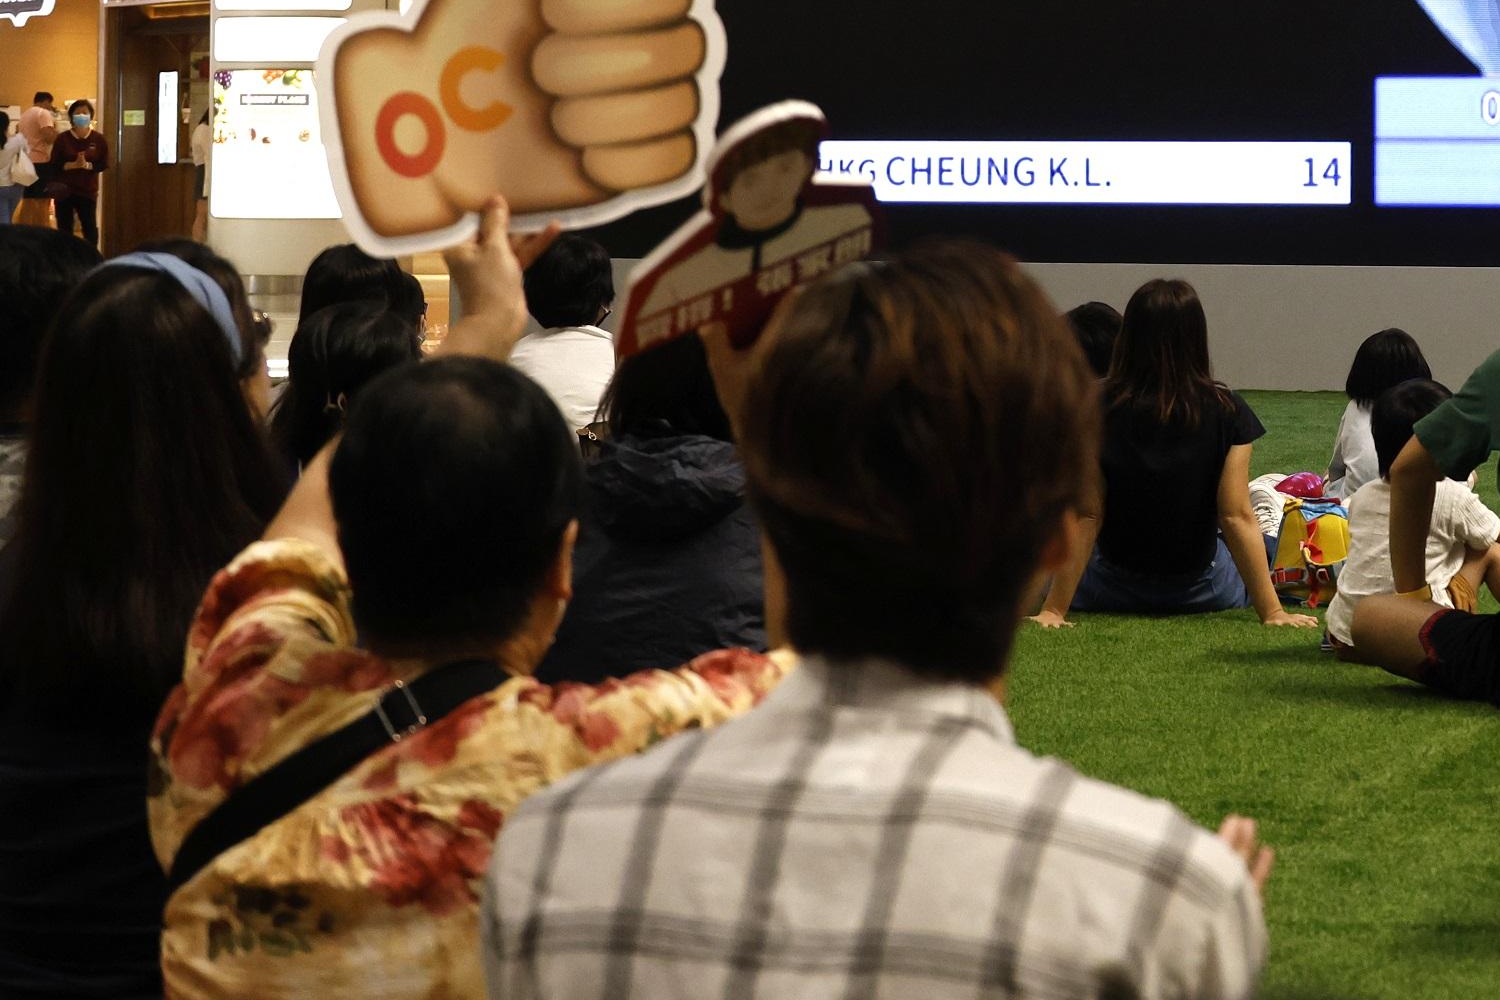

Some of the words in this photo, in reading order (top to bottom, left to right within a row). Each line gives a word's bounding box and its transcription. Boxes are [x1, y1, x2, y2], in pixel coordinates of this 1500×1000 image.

[375, 44, 514, 179] OC
[886, 156, 1035, 187] CHEUNG
[1048, 157, 1111, 187] K.L.
[1302, 158, 1341, 186] 14
